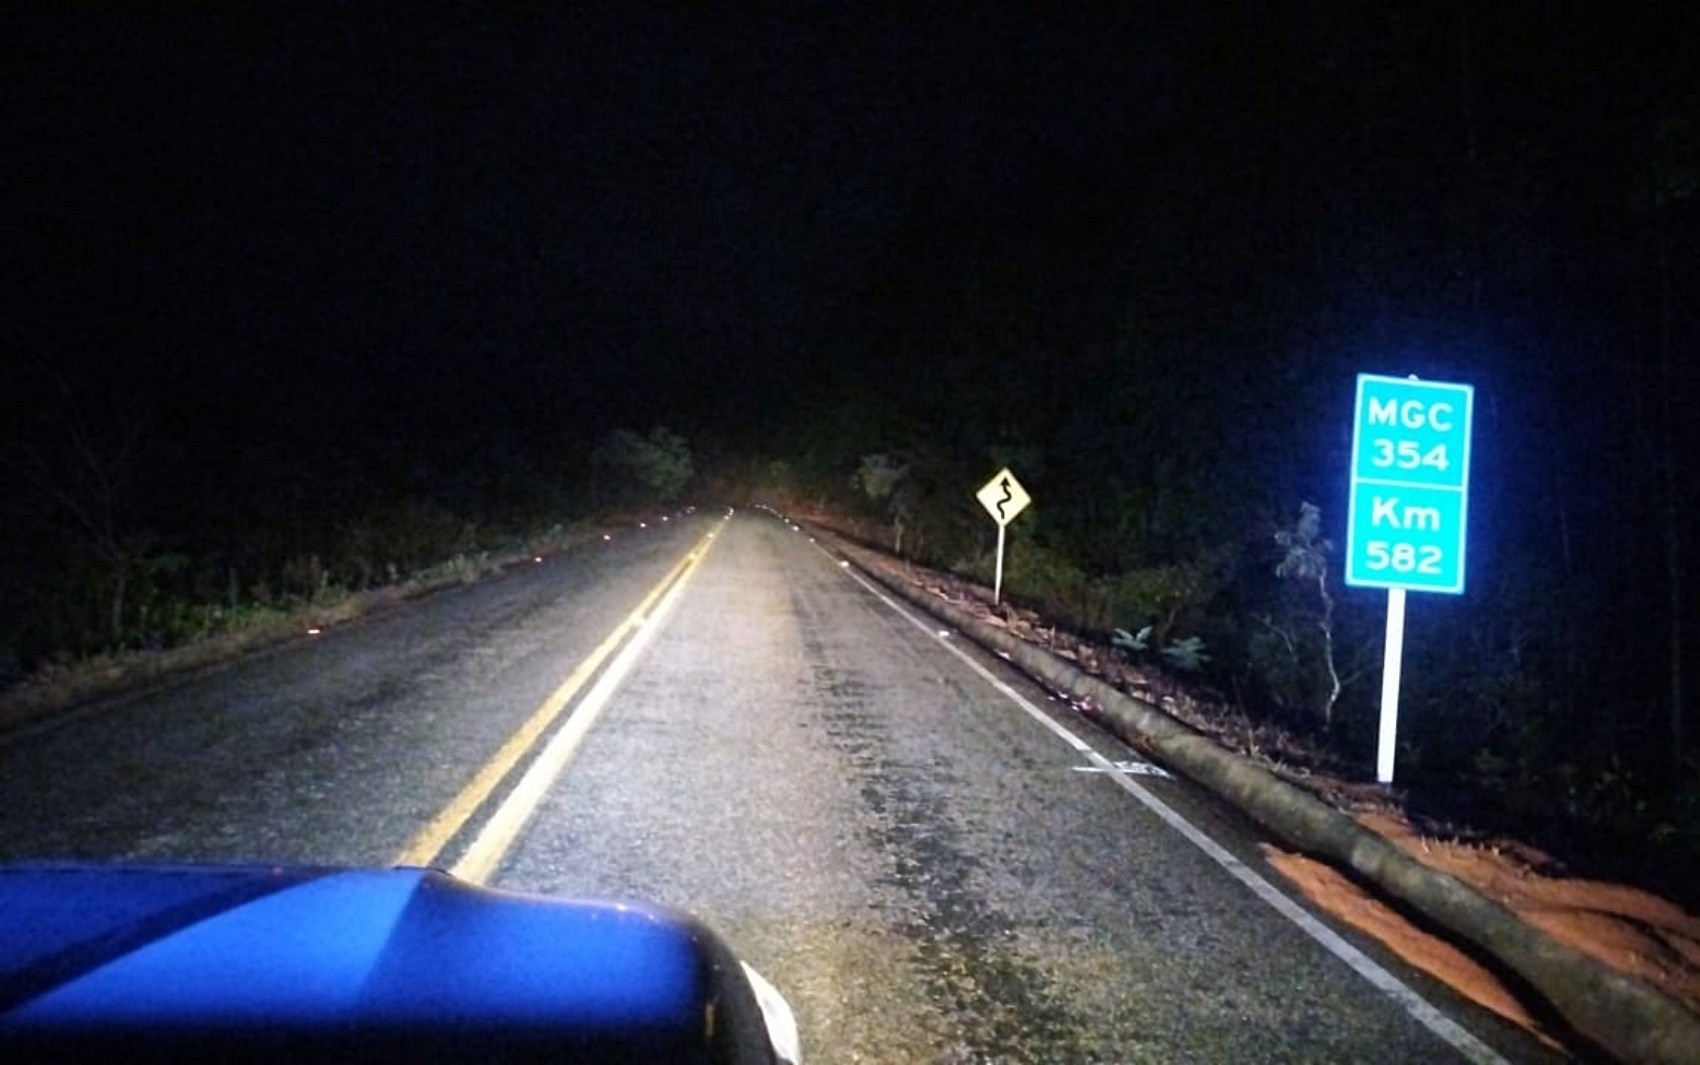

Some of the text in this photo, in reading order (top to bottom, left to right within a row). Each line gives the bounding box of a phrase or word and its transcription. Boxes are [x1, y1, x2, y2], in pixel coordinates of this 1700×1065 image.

[1368, 397, 1453, 431] MGC
[1372, 438, 1449, 471] 354
[1371, 496, 1441, 531] Km
[1366, 540, 1443, 574] 582
